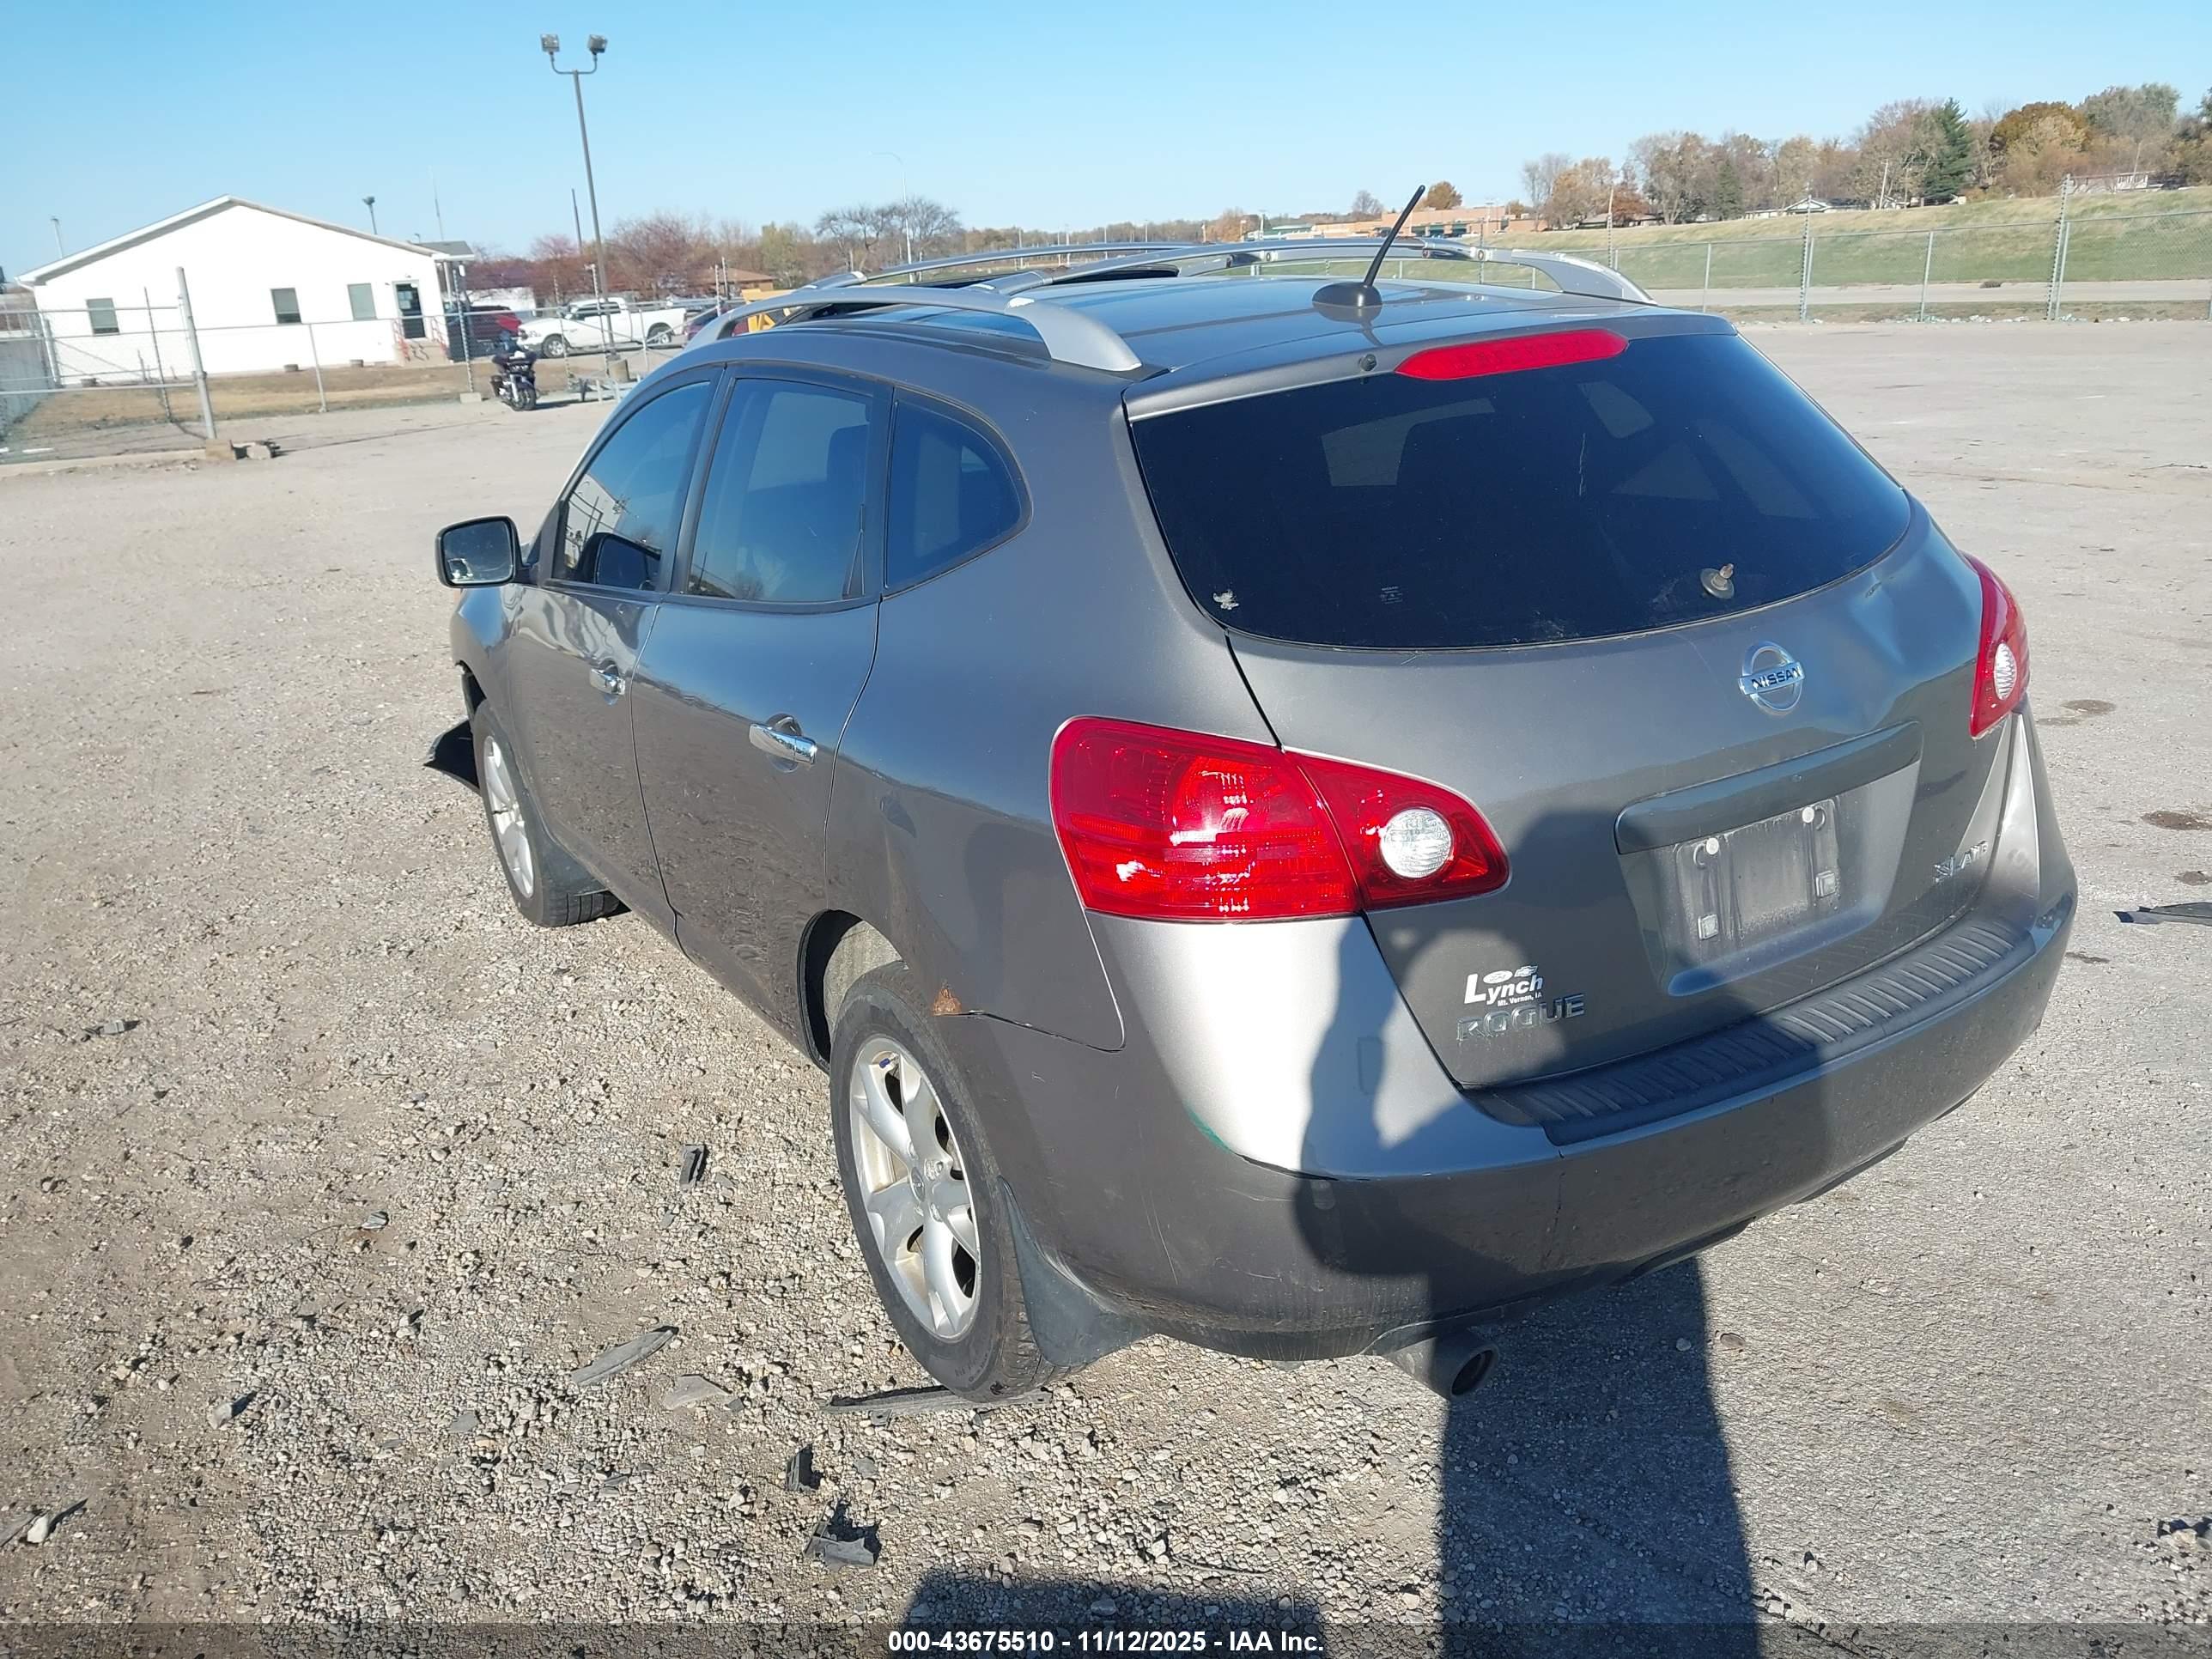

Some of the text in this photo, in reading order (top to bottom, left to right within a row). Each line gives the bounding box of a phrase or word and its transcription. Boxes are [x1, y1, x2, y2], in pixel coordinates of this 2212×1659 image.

[1752, 666, 1800, 688] NISSAN
[1464, 973, 1543, 1006] Lynch
[1456, 993, 1584, 1041] ROGUE
